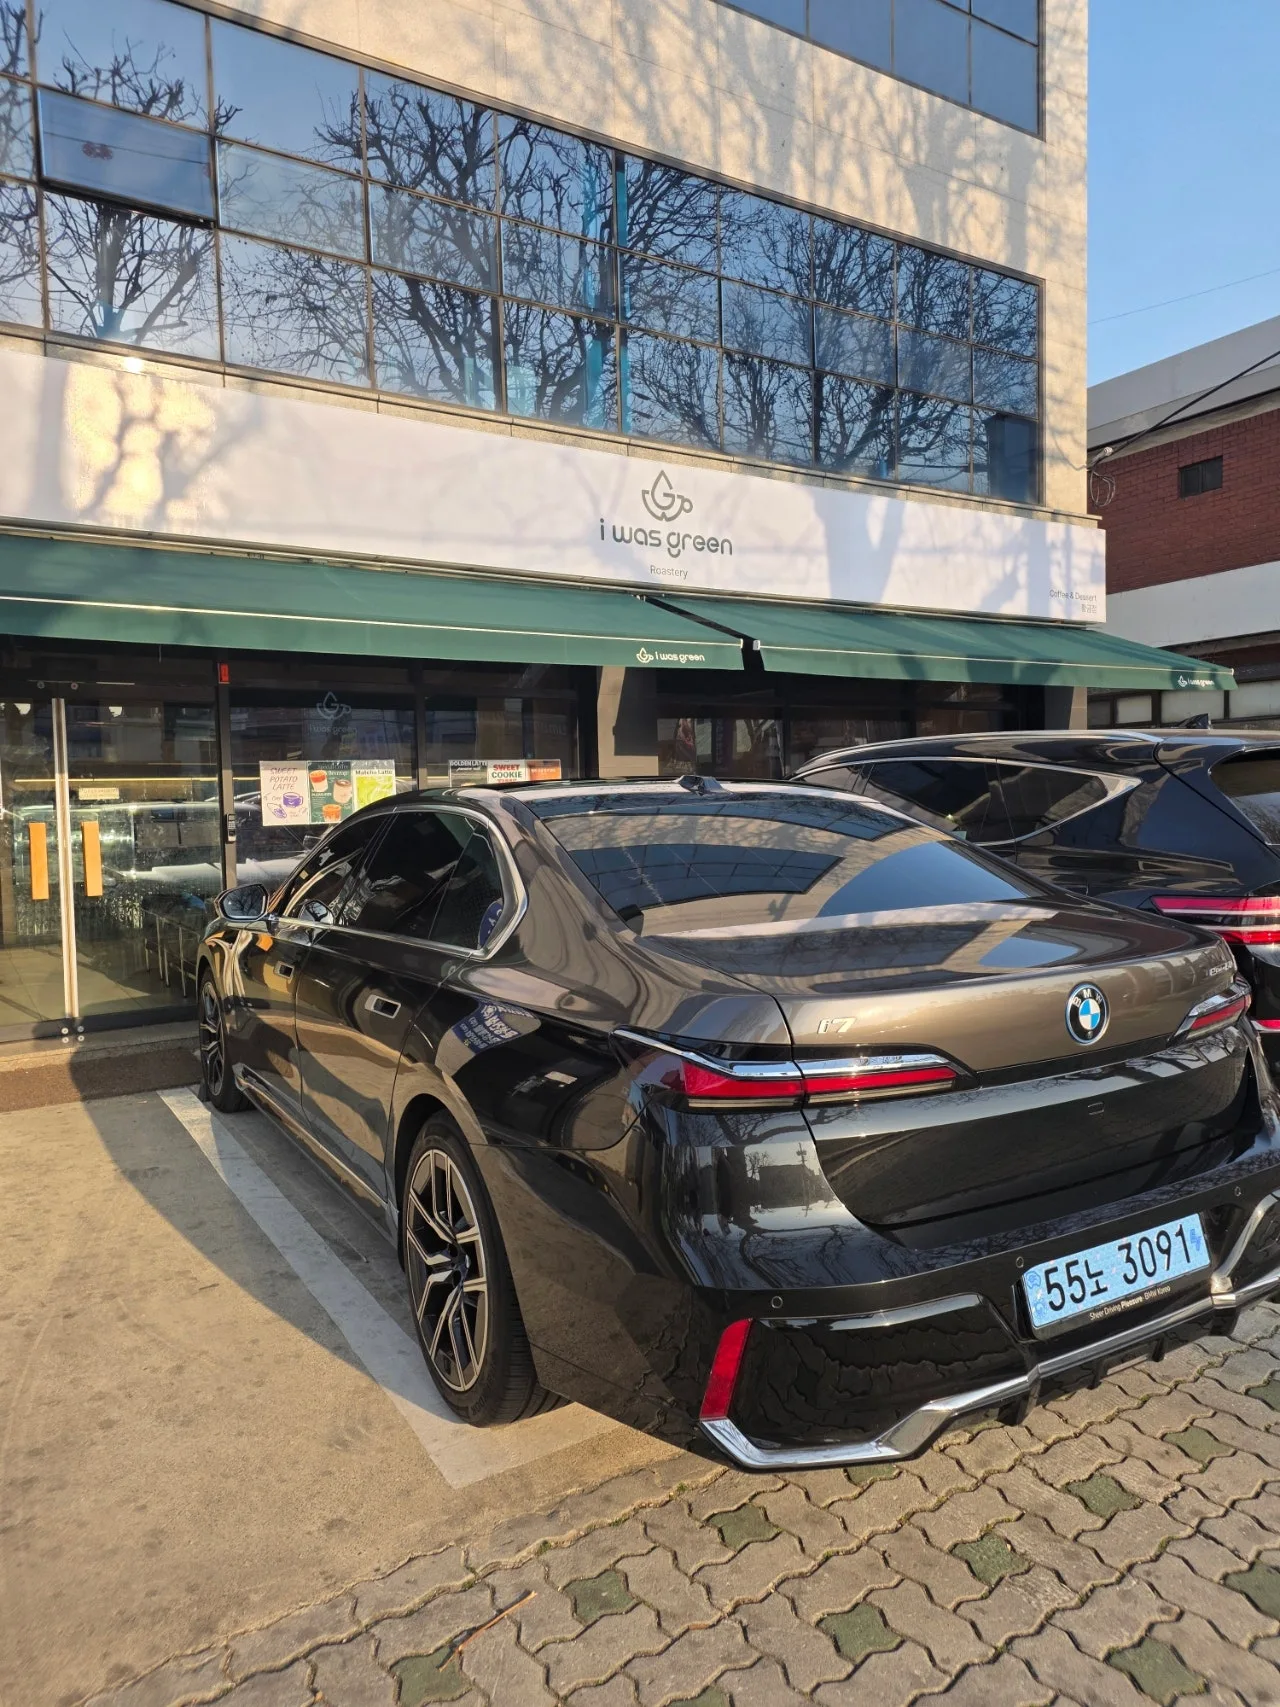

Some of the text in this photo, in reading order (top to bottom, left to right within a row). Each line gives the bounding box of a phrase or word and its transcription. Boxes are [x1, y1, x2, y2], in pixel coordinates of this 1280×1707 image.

[600, 518, 733, 558] i was green
[650, 564, 689, 580] Roastery
[1049, 589, 1069, 599] Coffee
[1075, 592, 1097, 602] Dessert
[679, 654, 706, 664] green
[269, 775, 298, 783] POTATO
[272, 783, 295, 791] LATTE
[817, 1017, 857, 1034] i7
[1044, 1224, 1191, 1311] 55노 3091
[1089, 1309, 1105, 1321] Sheer
[1104, 1304, 1121, 1315] Driving
